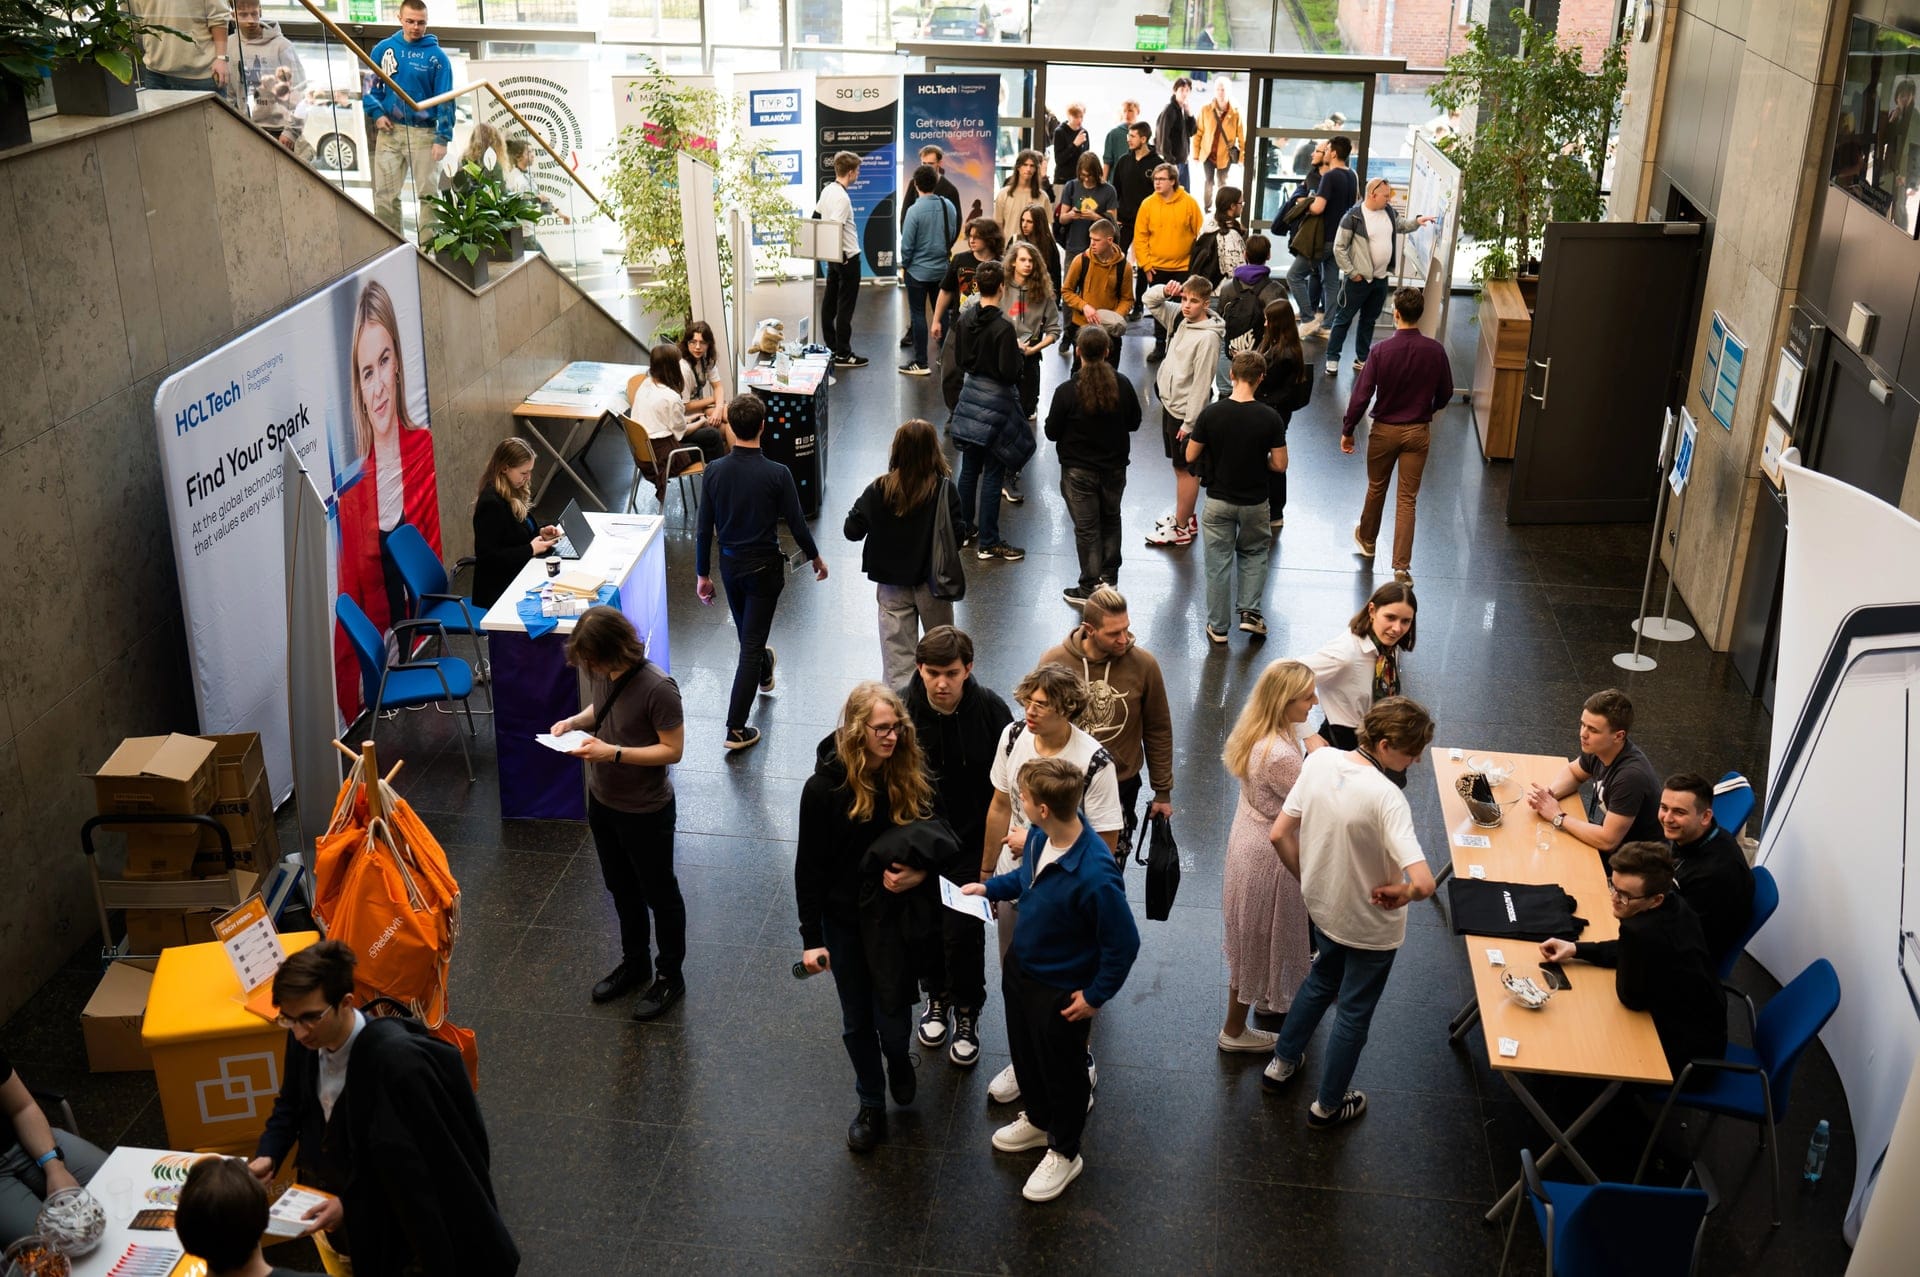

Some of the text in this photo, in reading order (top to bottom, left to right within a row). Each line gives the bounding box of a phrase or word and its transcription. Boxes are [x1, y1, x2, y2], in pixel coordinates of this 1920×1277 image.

[836, 87, 880, 102] sages
[918, 85, 957, 94] HCLTech
[759, 113, 793, 122] KRAKÓW
[915, 117, 984, 129] Get ready for a
[910, 129, 974, 141] supercharged
[175, 353, 284, 436] HCLTech Supercharging
[186, 403, 310, 508] Find Your Spark
[192, 521, 202, 538] At
[203, 511, 217, 529] the
[218, 490, 244, 521] global
[194, 535, 213, 556] that
[213, 516, 240, 541] values
[240, 501, 260, 523] every
[261, 486, 276, 507] skill
